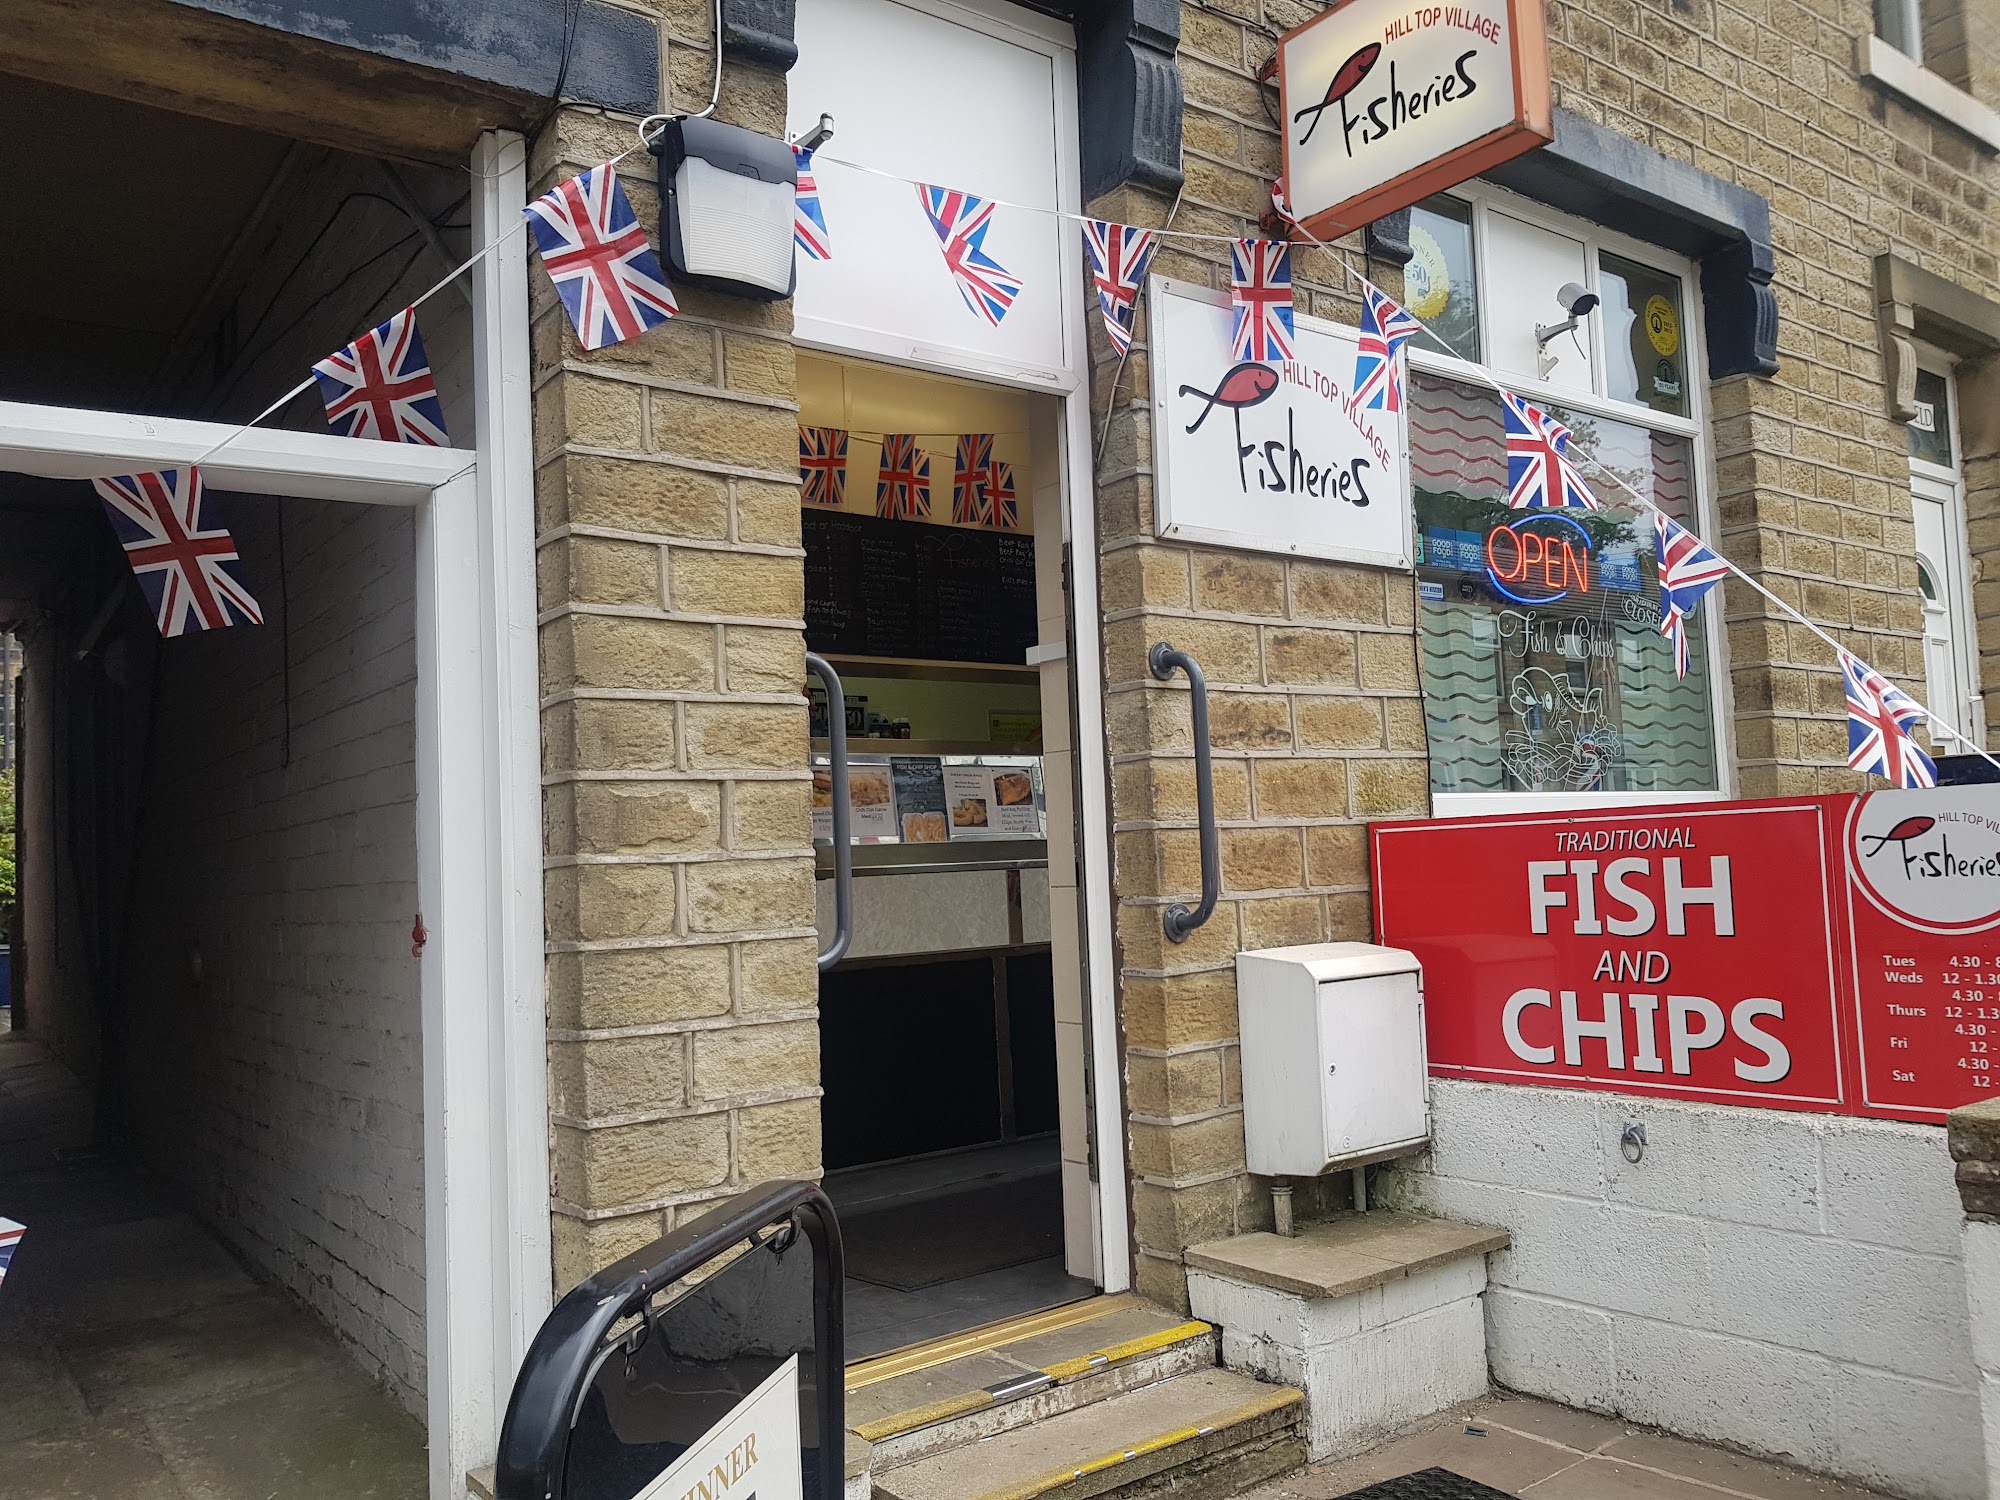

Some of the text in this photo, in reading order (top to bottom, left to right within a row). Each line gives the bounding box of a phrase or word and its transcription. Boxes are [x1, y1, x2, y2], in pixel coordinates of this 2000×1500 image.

[1384, 6, 1502, 45] HILL TOP VILLAGE
[1338, 49, 1478, 158] Fisheries
[1412, 263, 1428, 285] 50
[1283, 360, 1391, 473] HILL TOP VILLAGE
[1232, 403, 1371, 508] Fisheries
[1431, 538, 1451, 549] GOOD
[1432, 546, 1451, 557] FOOD
[1459, 543, 1478, 553] GOOD
[1459, 551, 1478, 561] FOOD
[1487, 525, 1588, 592] OPEN
[1497, 609, 1550, 658] Fish
[1573, 614, 1615, 659] Chips
[1937, 811, 1960, 823] HILL
[1962, 812, 1984, 825] TOP
[1554, 826, 1696, 853] TRADITIONAL
[1900, 832, 2000, 881] Fisherie
[1527, 854, 1736, 938] FISH
[1592, 949, 1671, 984] AND
[1882, 954, 1916, 967] Tues
[1949, 956, 1981, 968] 4.30
[1884, 971, 1924, 984] Weds
[1942, 973, 1960, 985] 12
[1951, 989, 1984, 1002] 4.30
[1886, 1003, 1927, 1017] Thurs
[1944, 1006, 1963, 1018] 12
[1977, 1007, 2000, 1020] 1.3
[1501, 987, 1792, 1084] CHIPS
[1954, 1023, 1987, 1036] 4.30
[1889, 1036, 1908, 1049] Fri
[1969, 1041, 1988, 1053] 12
[1957, 1057, 1990, 1071] 4.30
[1892, 1069, 1916, 1083] Sat
[1972, 1075, 1991, 1088] 12
[681, 1432, 759, 1500] NNER
